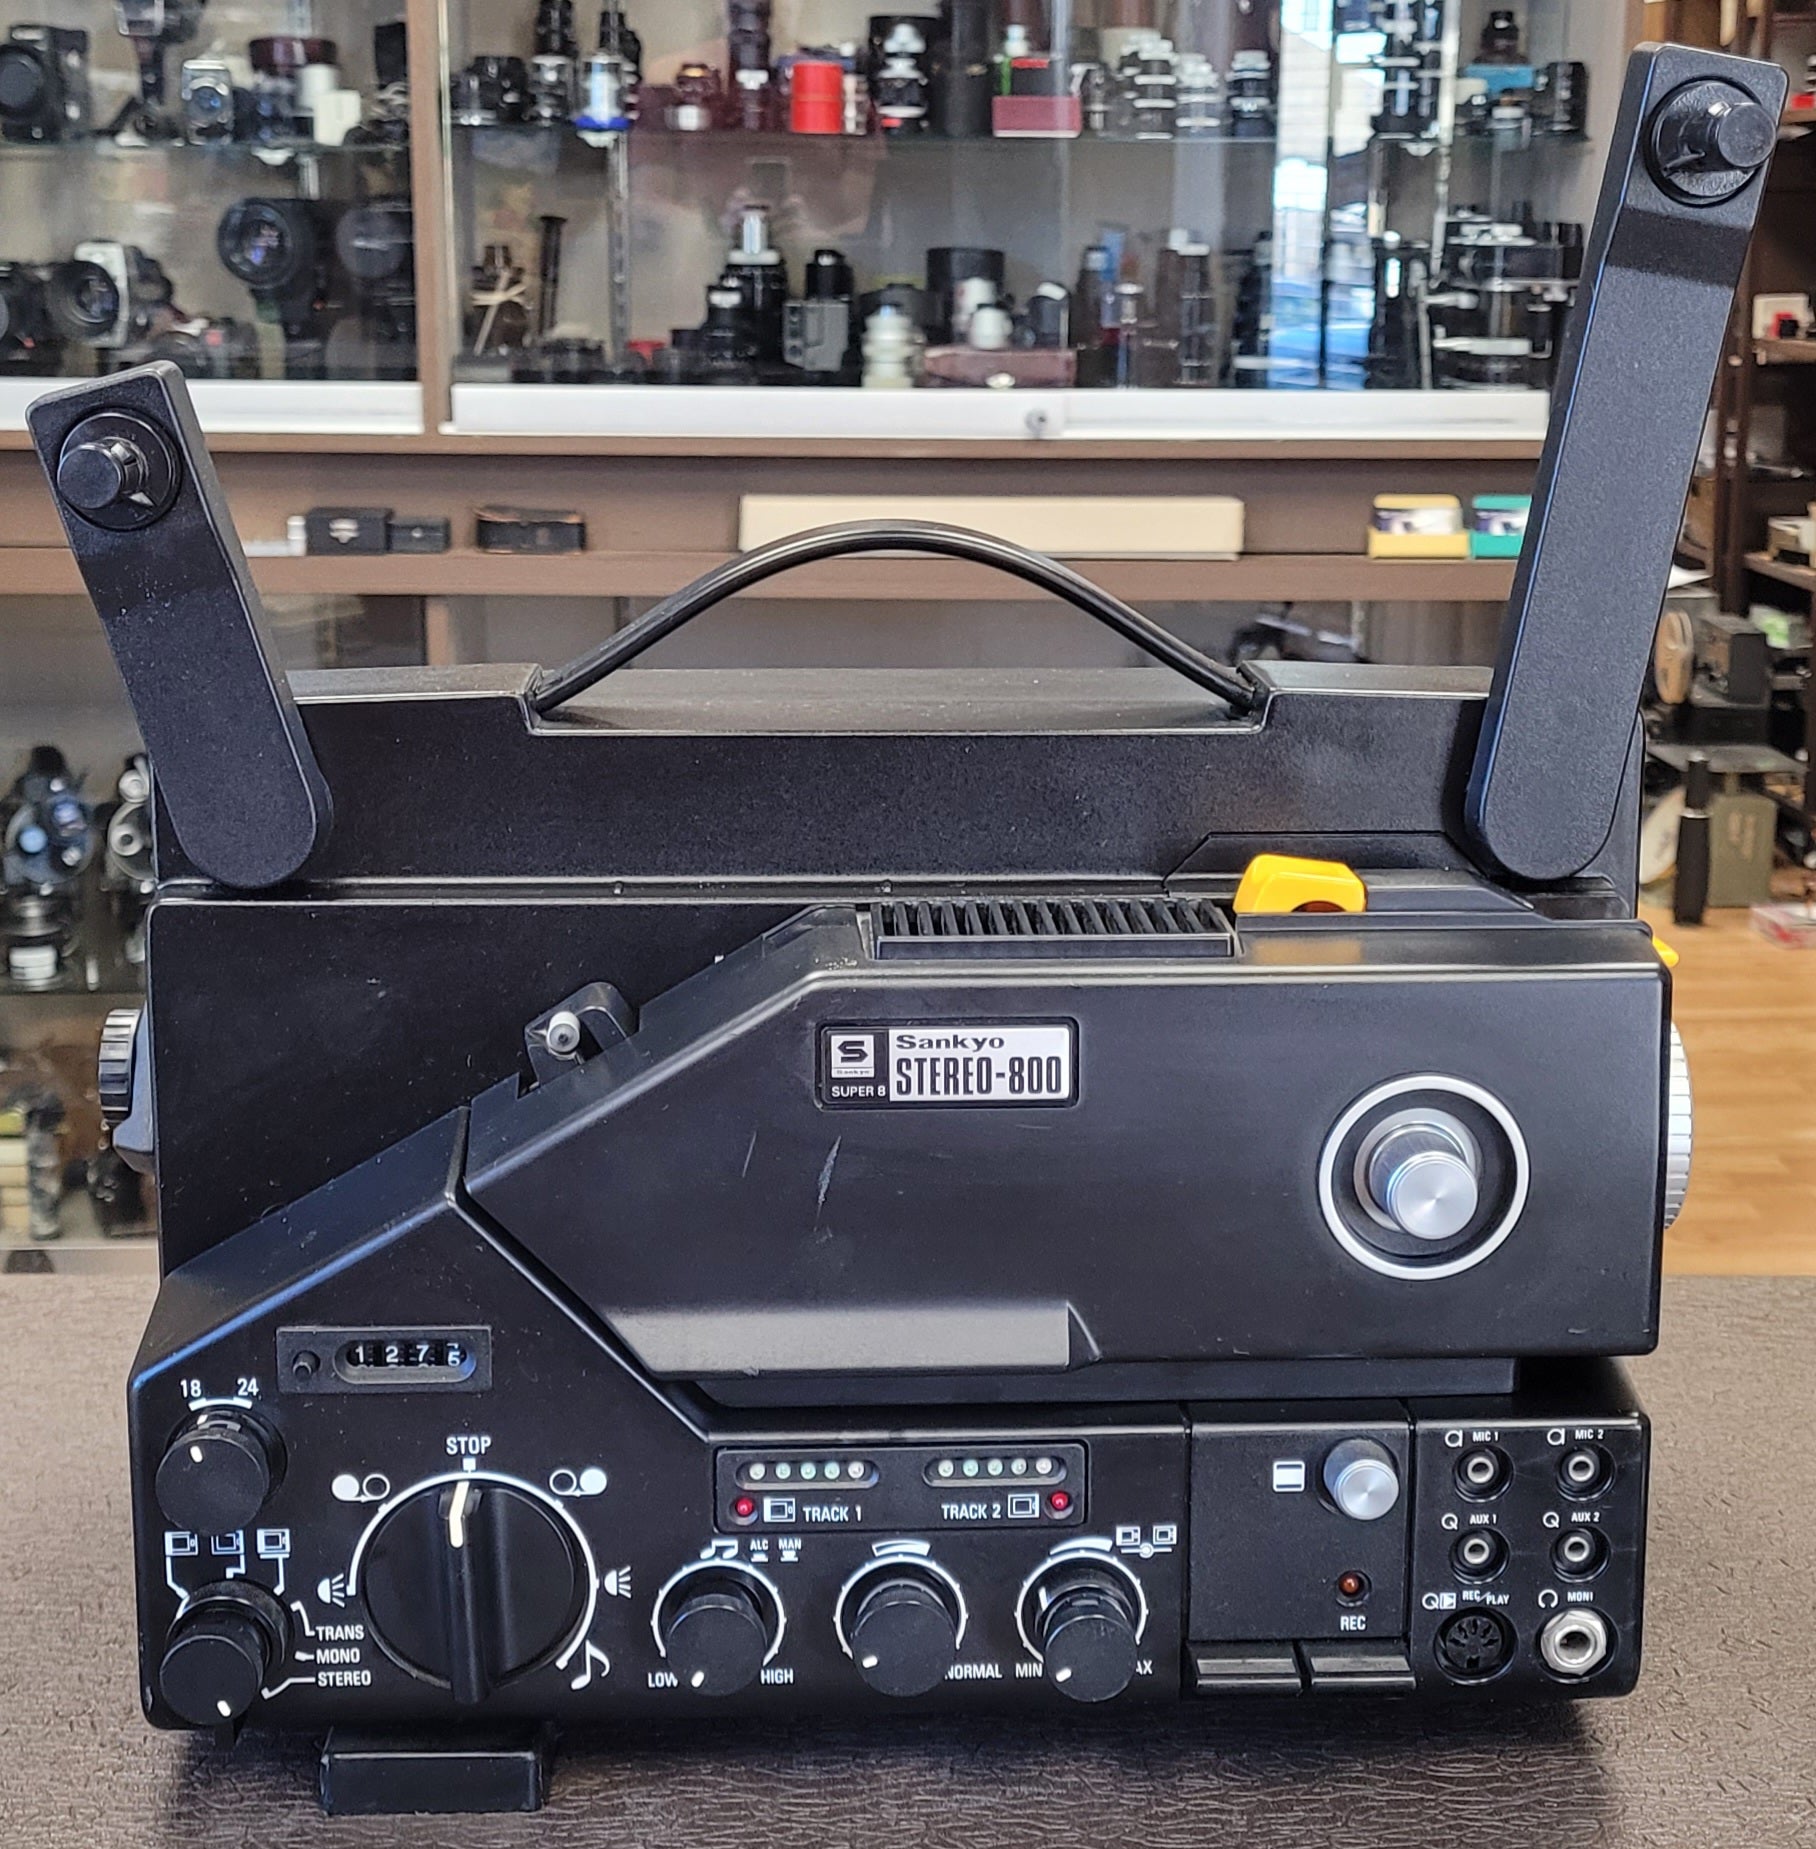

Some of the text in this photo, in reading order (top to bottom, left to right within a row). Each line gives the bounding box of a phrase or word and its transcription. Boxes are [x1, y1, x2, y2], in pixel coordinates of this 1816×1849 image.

[896, 1034, 1005, 1052] Sankyo
[896, 1056, 1062, 1096] STEREO-800
[831, 1085, 886, 1097] SUPER 8
[180, 1380, 202, 1398] 18
[237, 1379, 259, 1397] 24
[1472, 1431, 1499, 1442] MIC 1
[1575, 1429, 1604, 1440] MIC 2
[446, 1436, 492, 1455] STOP
[803, 1505, 862, 1522] TRACK 1
[941, 1503, 1001, 1520] TRACK 2
[1470, 1514, 1497, 1525] AUX 1
[1571, 1511, 1600, 1523] AUX 2
[750, 1538, 768, 1550] ALC
[778, 1538, 801, 1550] MAN
[1567, 1591, 1594, 1602] MONI
[1340, 1615, 1366, 1631] REC
[316, 1625, 364, 1641] TRANS
[316, 1648, 360, 1664] MONO
[760, 1668, 794, 1685] HIGH
[945, 1662, 1002, 1680] NORMAL
[1015, 1662, 1043, 1678] MIN
[317, 1671, 371, 1687] STEREO
[648, 1672, 678, 1688] LOW
